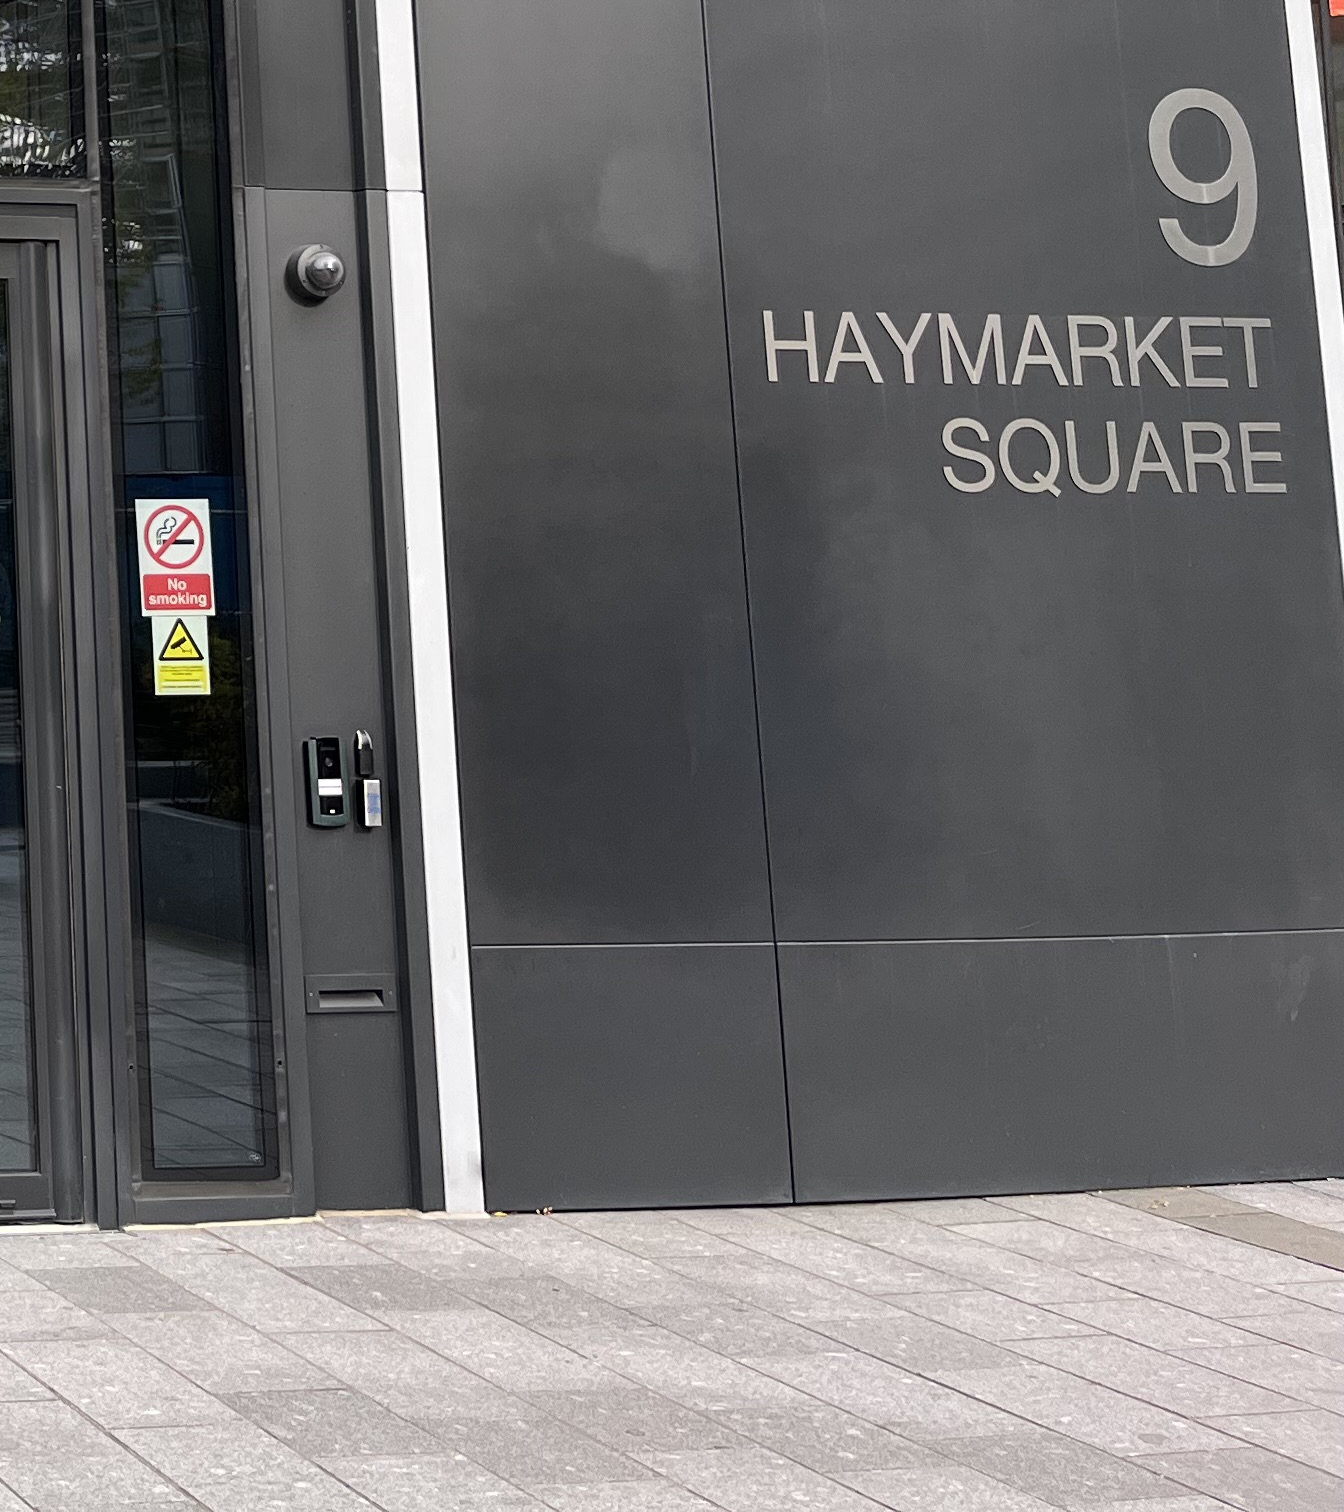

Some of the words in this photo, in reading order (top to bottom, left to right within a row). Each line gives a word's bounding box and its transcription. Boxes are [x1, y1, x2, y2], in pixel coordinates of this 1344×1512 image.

[1148, 88, 1258, 267] 9
[762, 310, 1271, 388] HAYMARKET
[942, 418, 1287, 497] SQUARE
[148, 592, 208, 608] smoking
[167, 578, 188, 591] No
